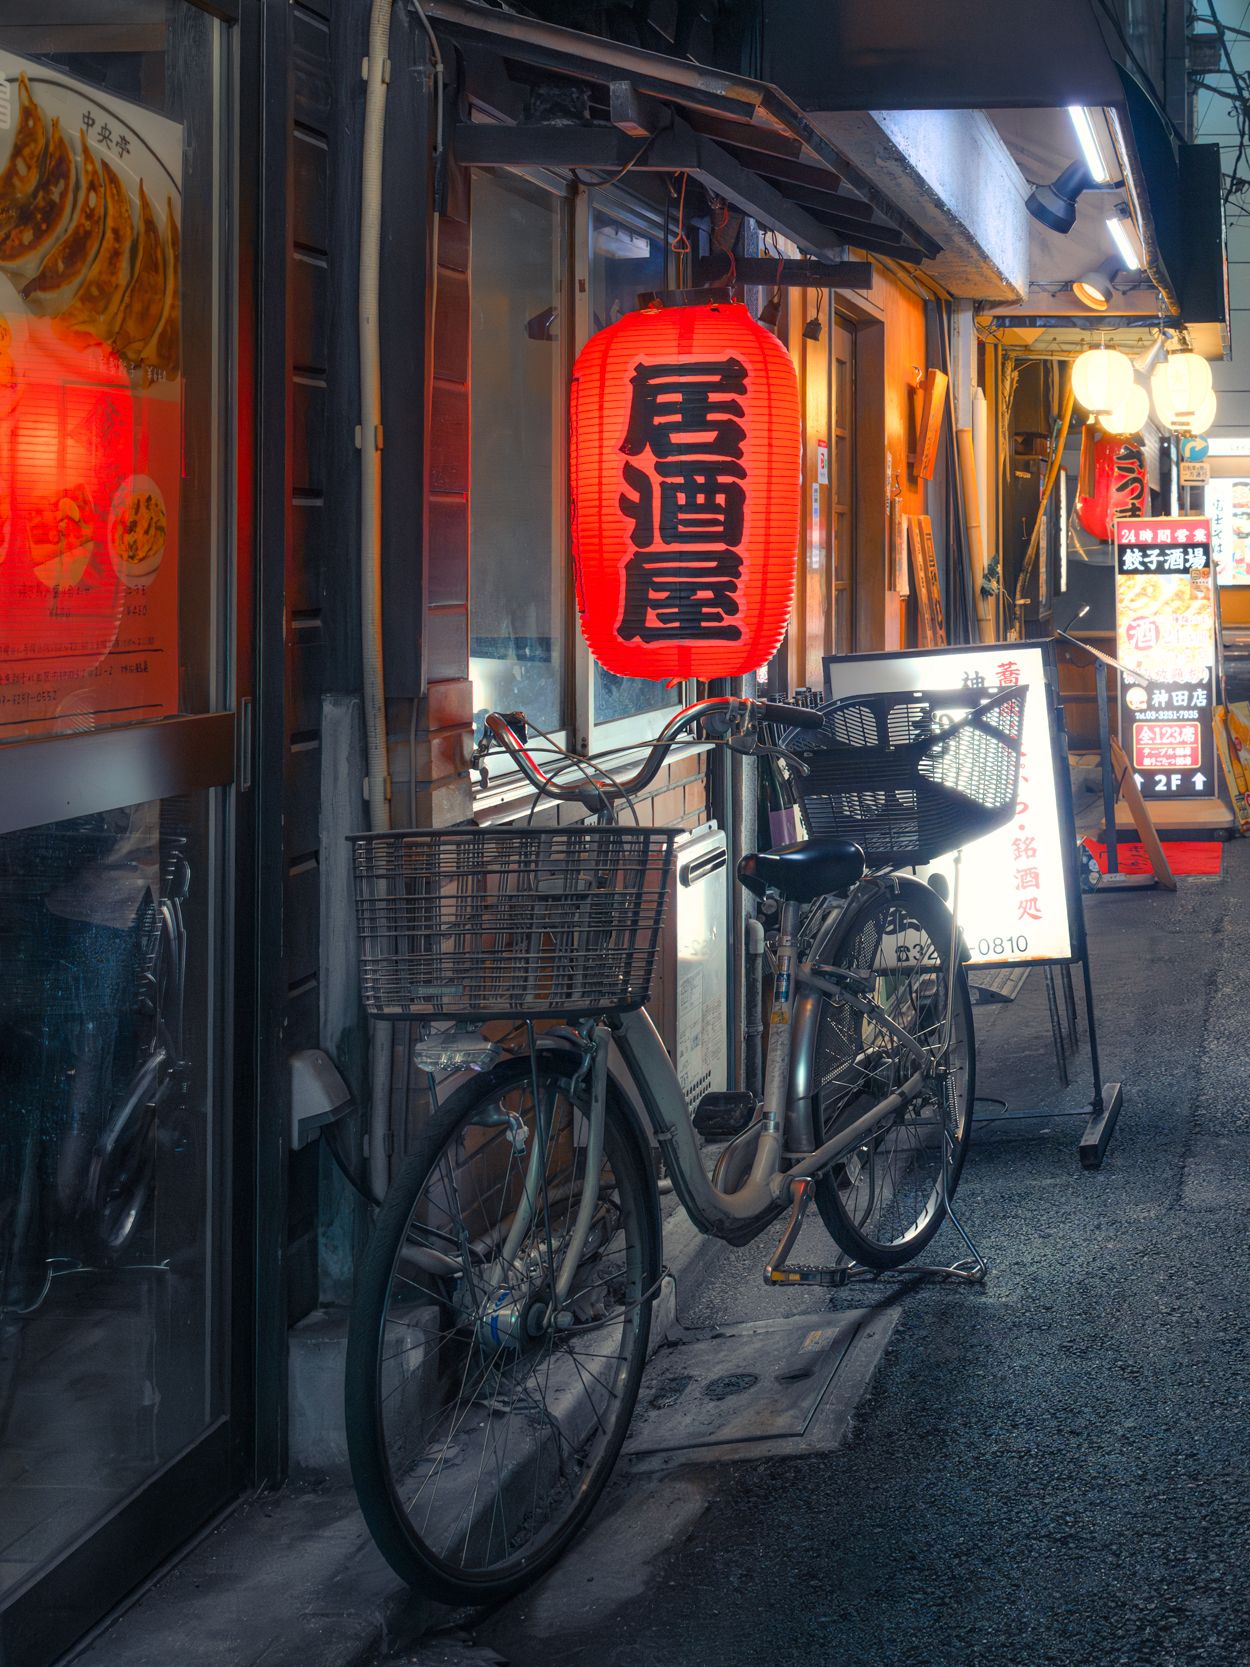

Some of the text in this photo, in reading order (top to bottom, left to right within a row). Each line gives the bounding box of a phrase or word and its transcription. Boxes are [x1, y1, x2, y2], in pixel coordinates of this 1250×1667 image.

[81, 110, 131, 159] 中央亭
[617, 356, 749, 644] 居酒屋
[1121, 528, 1208, 543] 24時間営業
[1122, 547, 1207, 570] 餃子酒場
[1129, 616, 1157, 649] 酒
[1151, 688, 1207, 707] 神田店
[1138, 726, 1196, 744] 全123席
[1154, 774, 1182, 791] 2F
